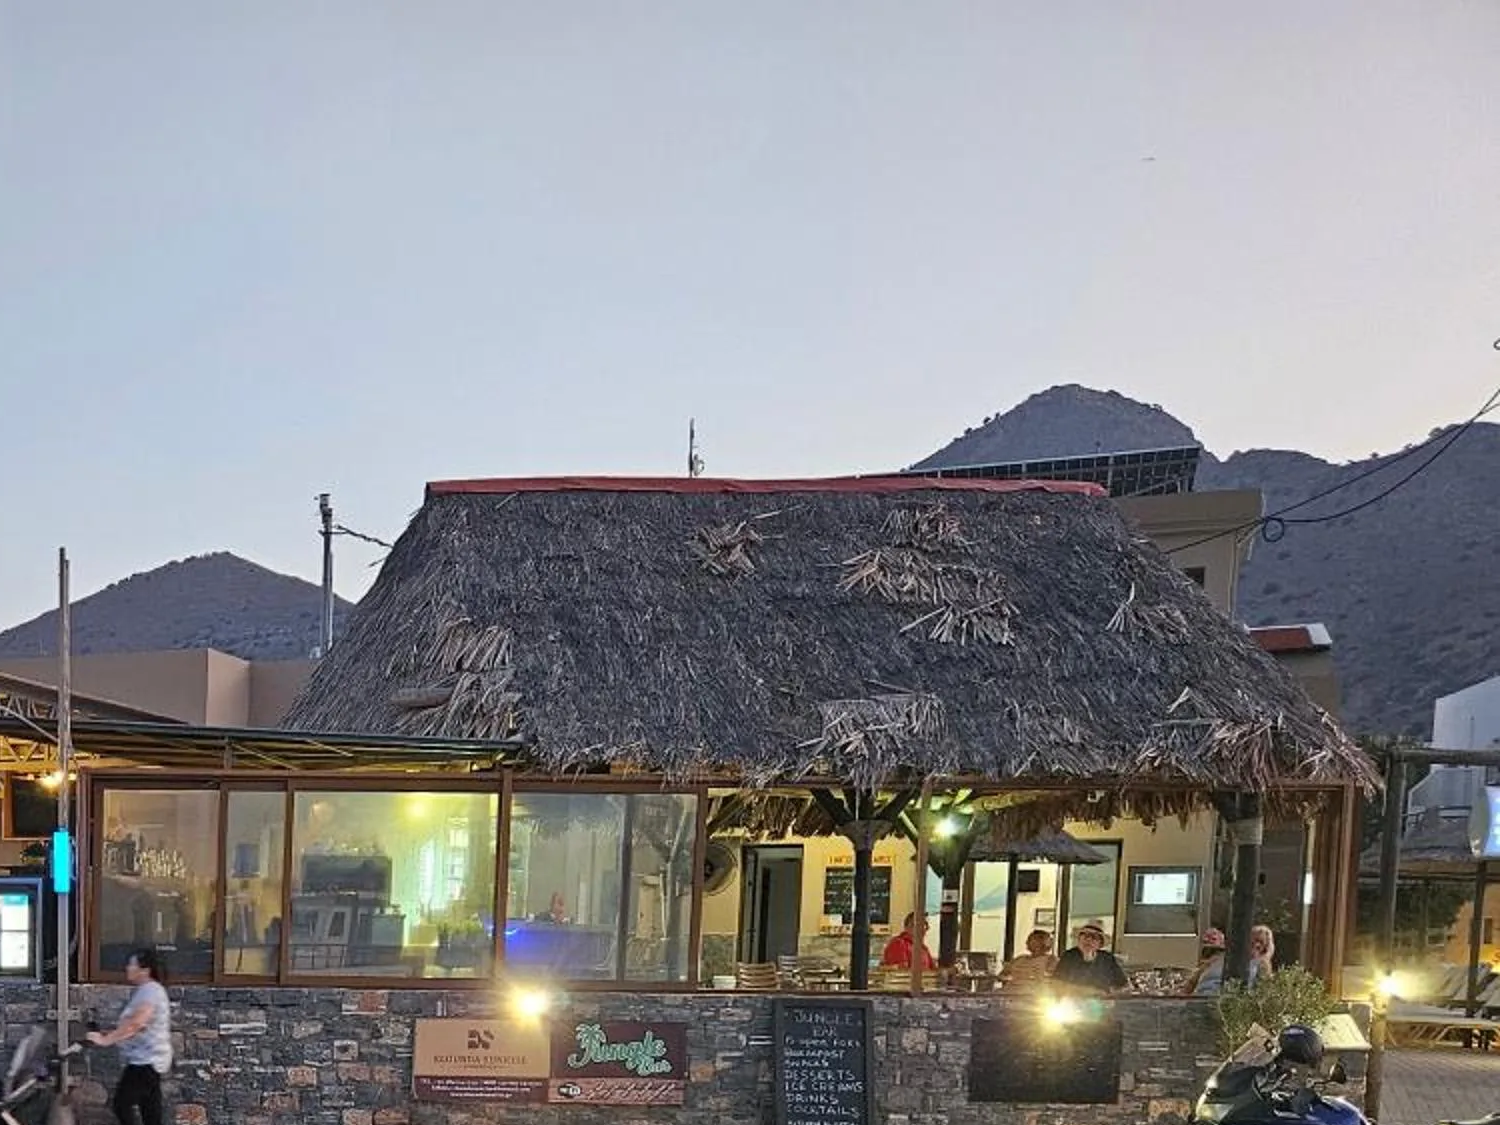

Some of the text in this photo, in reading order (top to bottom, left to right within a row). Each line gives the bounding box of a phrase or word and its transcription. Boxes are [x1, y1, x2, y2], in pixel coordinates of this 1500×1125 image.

[793, 1009, 853, 1026] JUNGLE
[784, 1069, 855, 1081] DESSERTS
[785, 1080, 807, 1091] ICE
[786, 1093, 839, 1105] DRINKS
[787, 1104, 860, 1118] COCKTAILS
